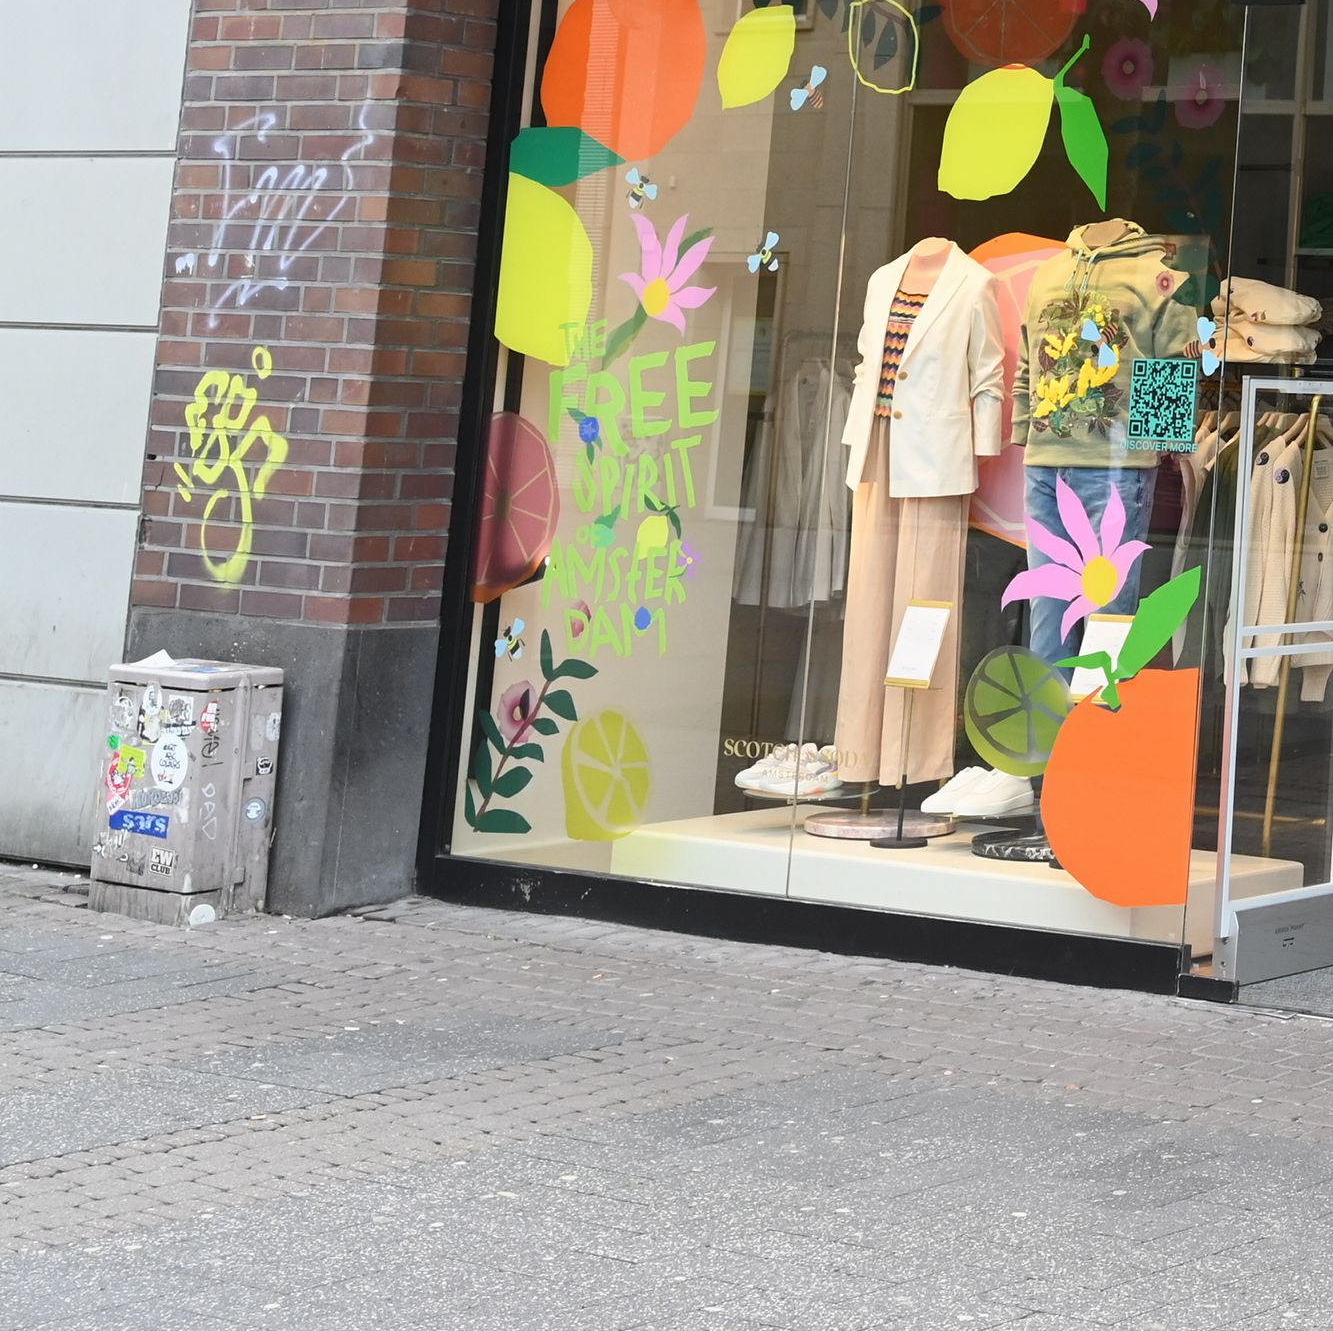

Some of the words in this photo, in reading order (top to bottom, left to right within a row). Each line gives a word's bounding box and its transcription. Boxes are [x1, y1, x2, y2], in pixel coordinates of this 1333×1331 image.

[559, 318, 608, 362] THE
[548, 340, 719, 457] FREE
[1120, 440, 1169, 452] DISCOVER
[1170, 442, 1197, 453] MORE
[571, 434, 702, 521] SPIRIT
[564, 602, 667, 659] DAM
[723, 738, 799, 763] SCOTCH
[150, 863, 171, 875] CLUB
